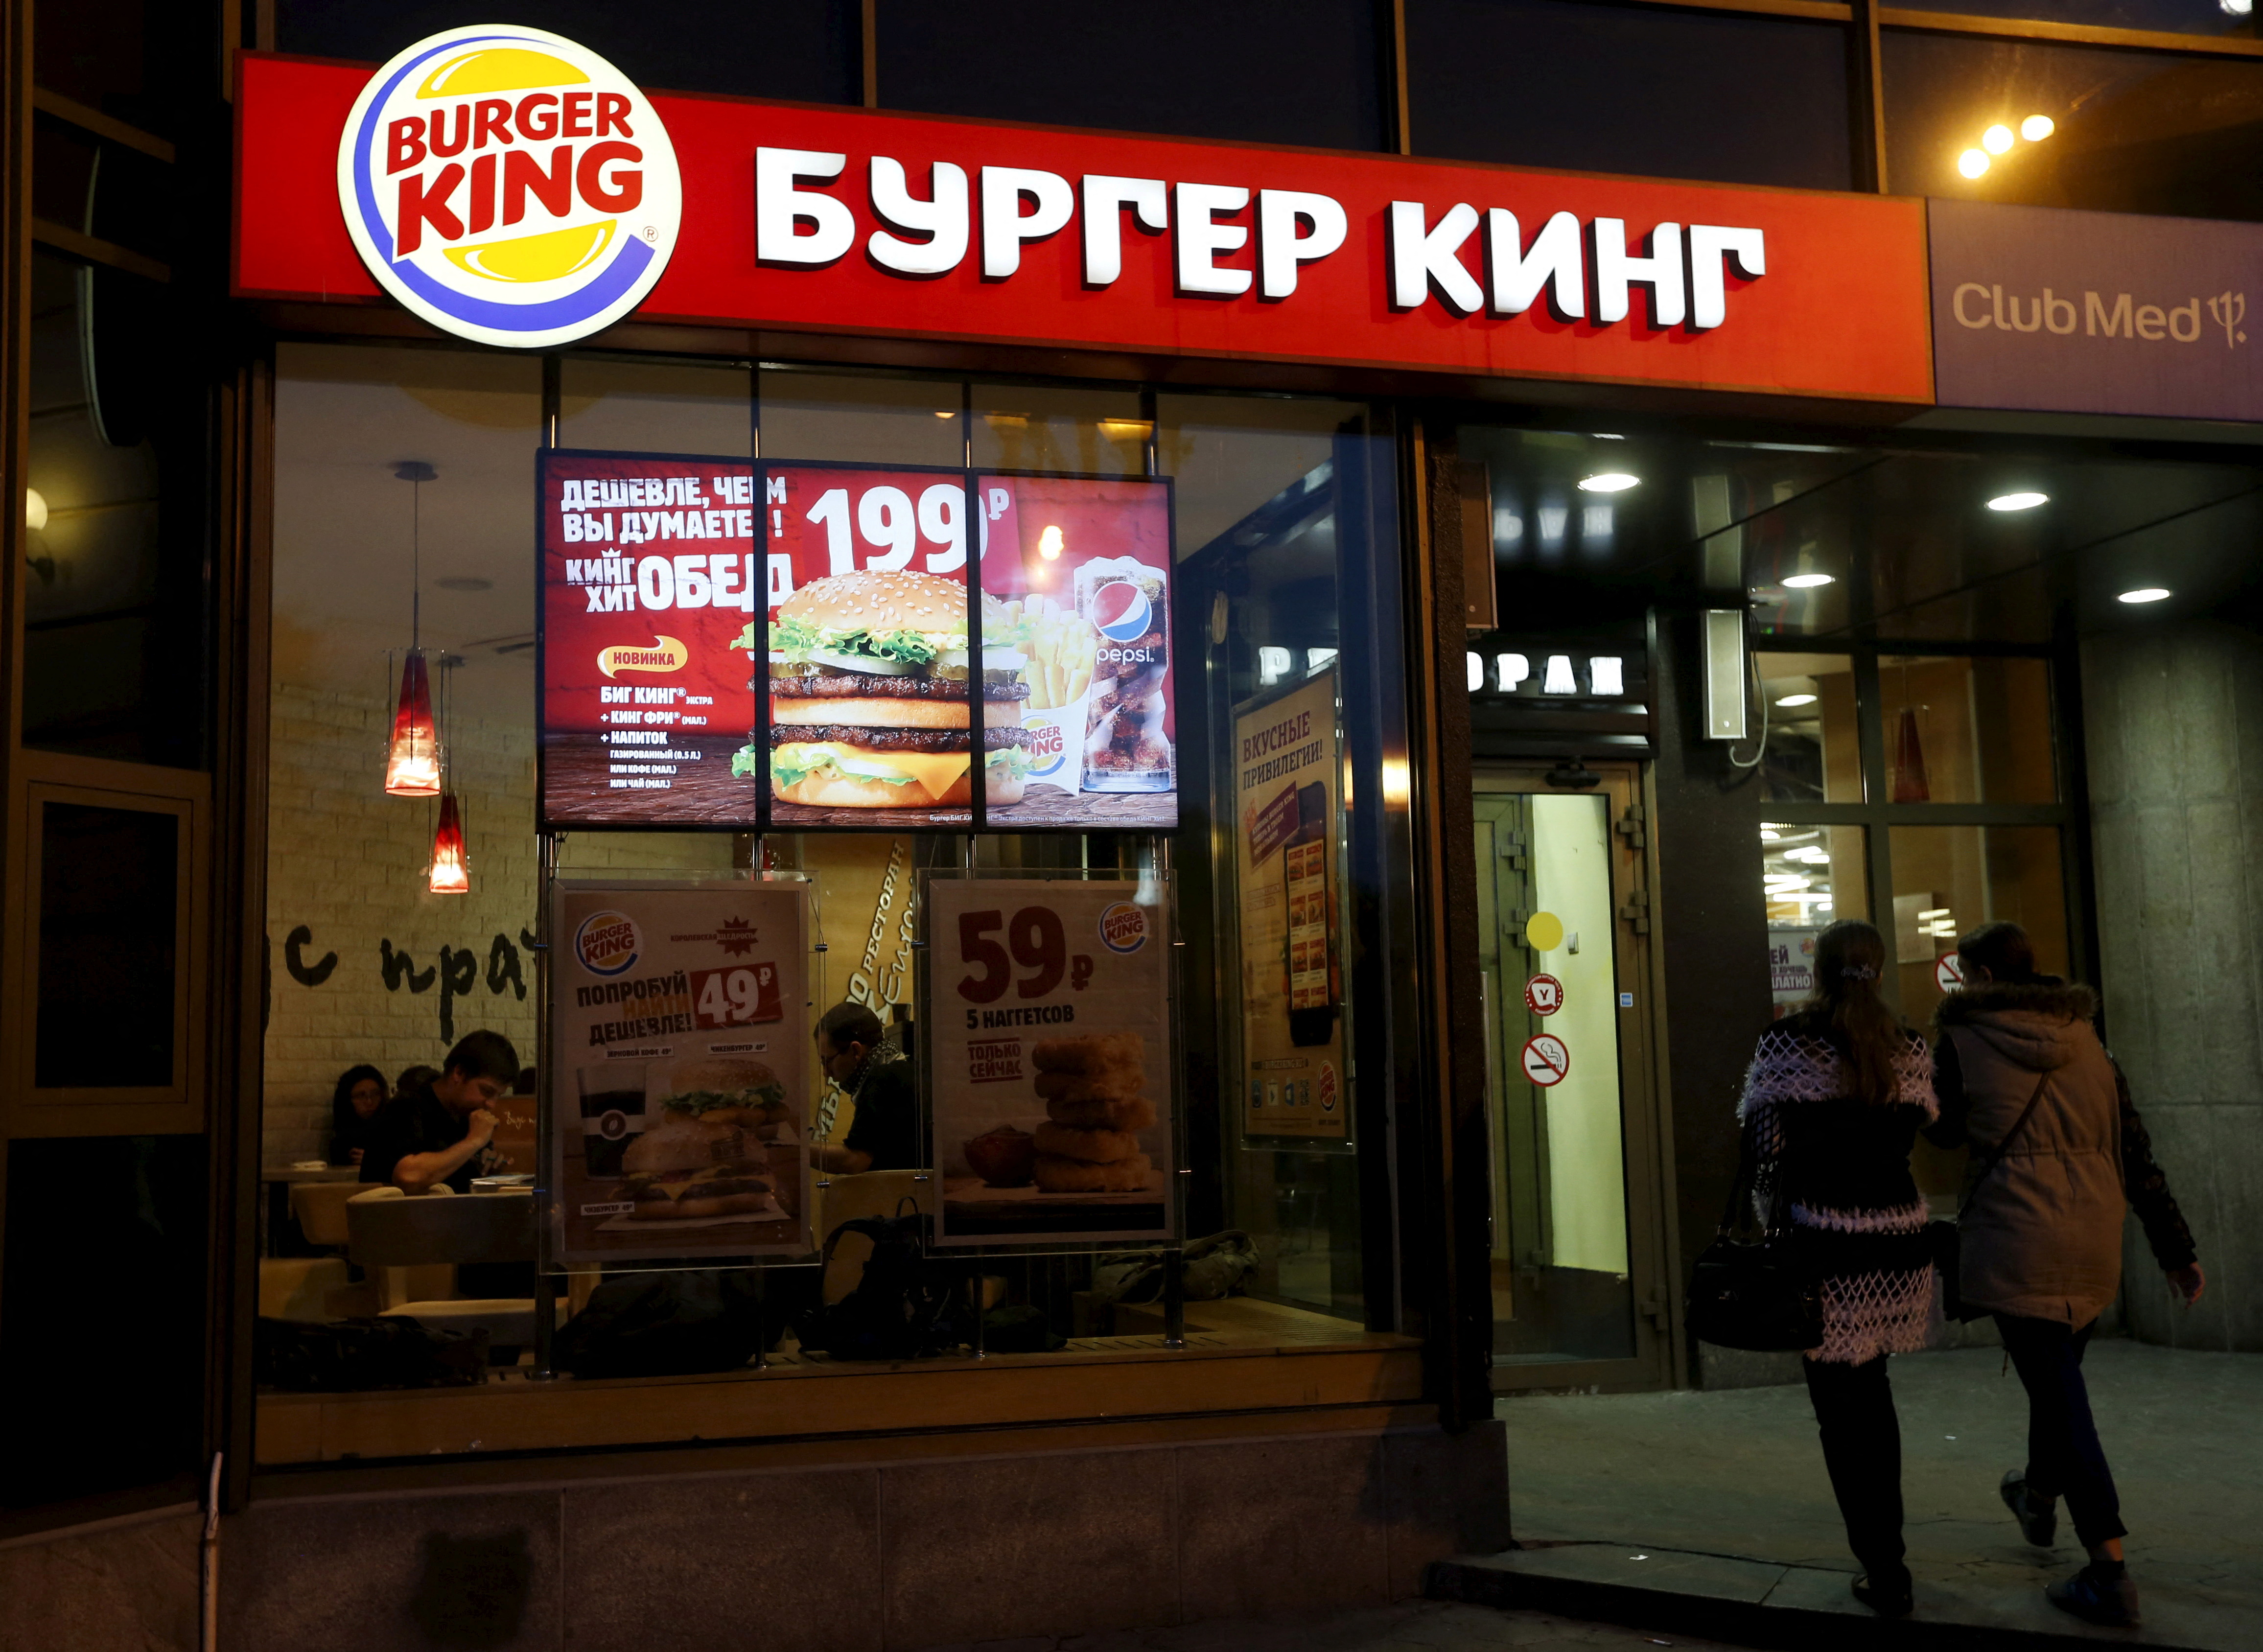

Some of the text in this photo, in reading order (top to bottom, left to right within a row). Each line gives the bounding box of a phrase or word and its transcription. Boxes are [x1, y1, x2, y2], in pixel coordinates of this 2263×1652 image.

[387, 92, 634, 175] BURGER
[397, 141, 643, 257] KING
[756, 146, 1765, 328] БУРГЕР КИНГ
[1953, 282, 2201, 342] Club Med
[561, 476, 787, 512] ДЕШЕВЛЕ, ЧЕМ
[562, 513, 614, 543] ВЫ
[565, 558, 635, 584] КИНГ
[637, 554, 796, 612] ОБЕД
[585, 584, 636, 612] ХИТ
[613, 652, 675, 666] НОВИНКА
[601, 686, 633, 703] БИГ
[686, 696, 714, 705] ЭКСТРА
[610, 710, 643, 724] КИНГ
[681, 716, 707, 725] (МАЛ.)
[610, 730, 668, 745] НАПИТОК
[1029, 726, 1061, 741] RGER
[1243, 711, 1310, 763] ВКУСНЫЕ
[610, 749, 673, 759] ГАЗИРОВАННЫЙ
[1022, 737, 1063, 757] ING
[610, 764, 677, 774] ИЛИ КОФЕ (МАЛ.)
[1243, 739, 1322, 790] ПРИВИЛЕГИИ!
[610, 777, 671, 789] ИЛИ ЧАЙ (МАЛ.)
[862, 840, 905, 975] РЕСТОРАН
[1105, 911, 1141, 930] BURGER
[1106, 920, 1143, 942] KING
[583, 923, 632, 948] BURGER
[585, 933, 634, 963] KING
[577, 970, 688, 1007] ПОПРОБУЙ
[967, 1004, 1074, 1029] 5 НАГГЕТСОВ
[589, 1013, 692, 1047] ДЕШЕВЛЕ!
[641, 1048, 659, 1056] КОФЕ
[710, 1044, 753, 1052] ЧИКЕНБУРГЕР
[968, 1043, 1021, 1060] ТОЛЬКО
[969, 1059, 1022, 1077] СЕЙЧАС
